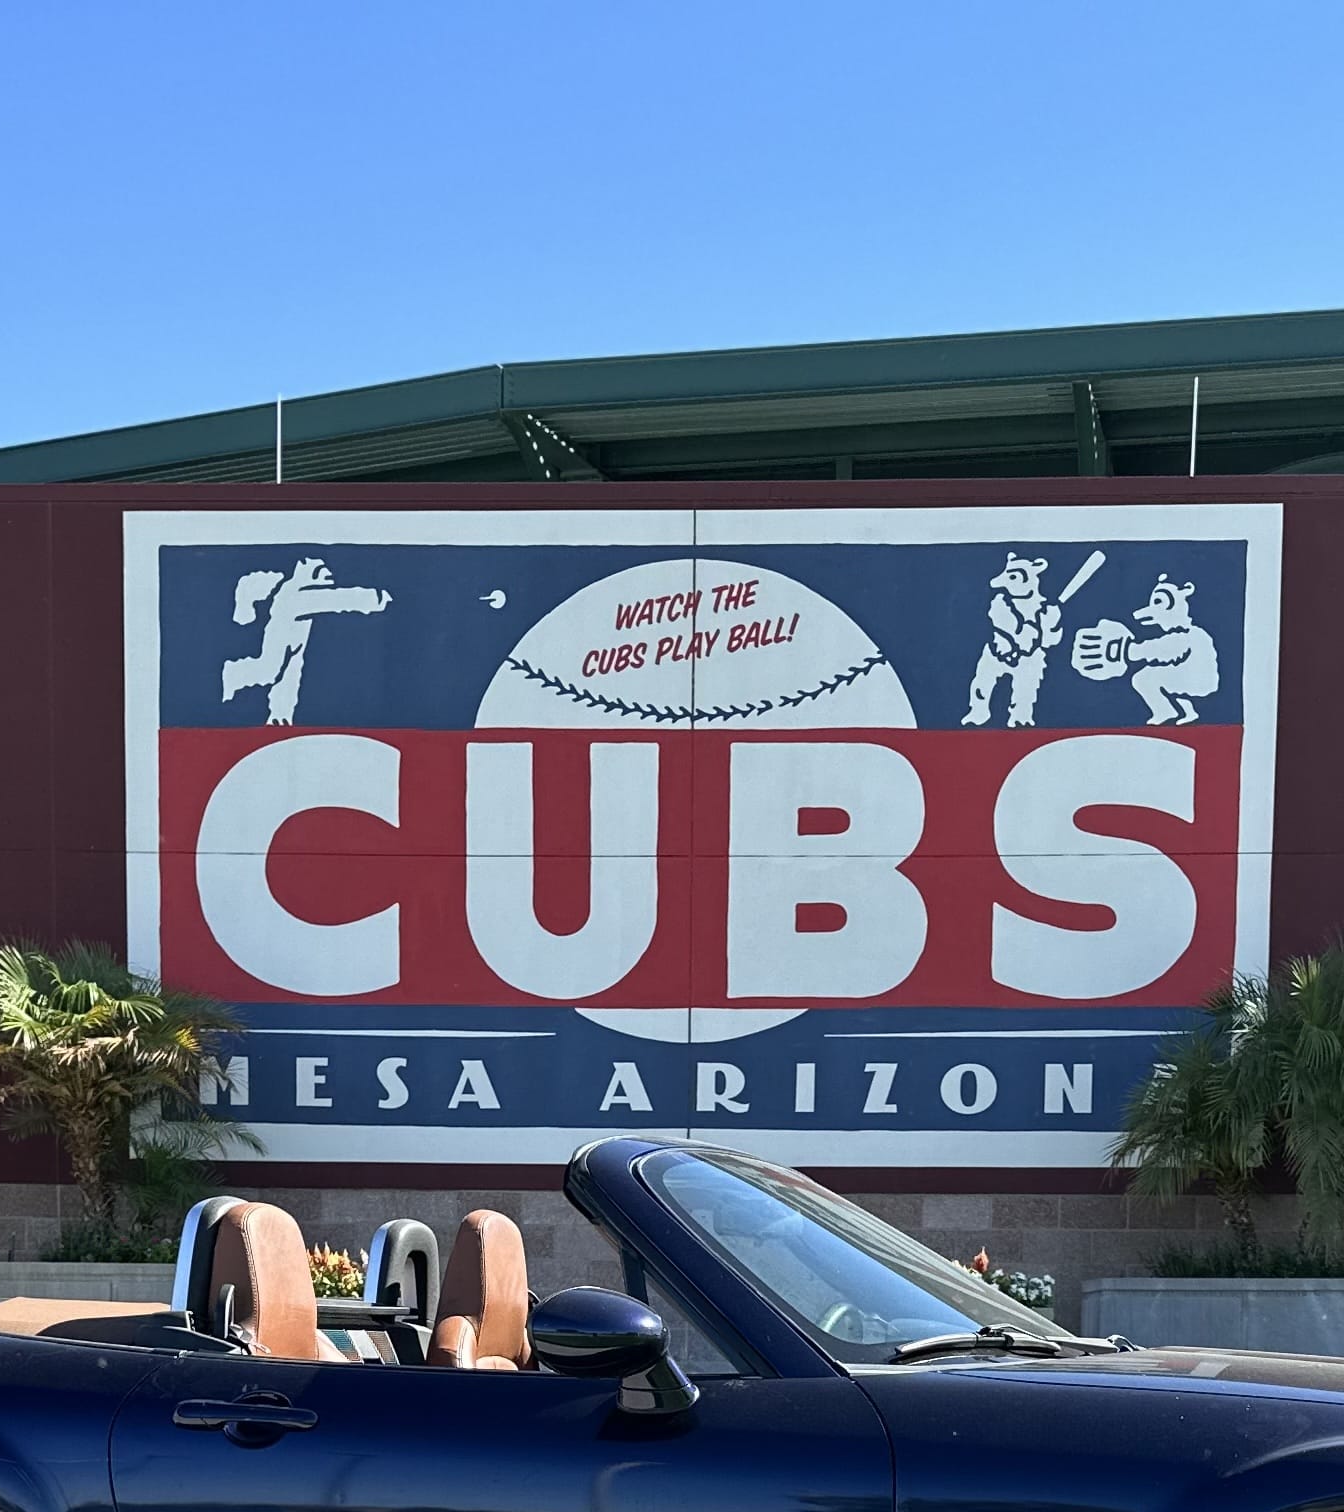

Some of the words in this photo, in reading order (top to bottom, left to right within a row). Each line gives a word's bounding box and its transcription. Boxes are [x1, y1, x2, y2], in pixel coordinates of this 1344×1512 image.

[615, 590, 702, 631] WATCH
[712, 579, 760, 614] THE
[581, 642, 648, 678] CUBS
[654, 628, 721, 666] PLAY
[726, 612, 800, 653] BALL!
[195, 733, 1199, 1000] CUBS
[198, 1055, 503, 1110] MESA
[599, 1061, 1185, 1115] ARIZON
